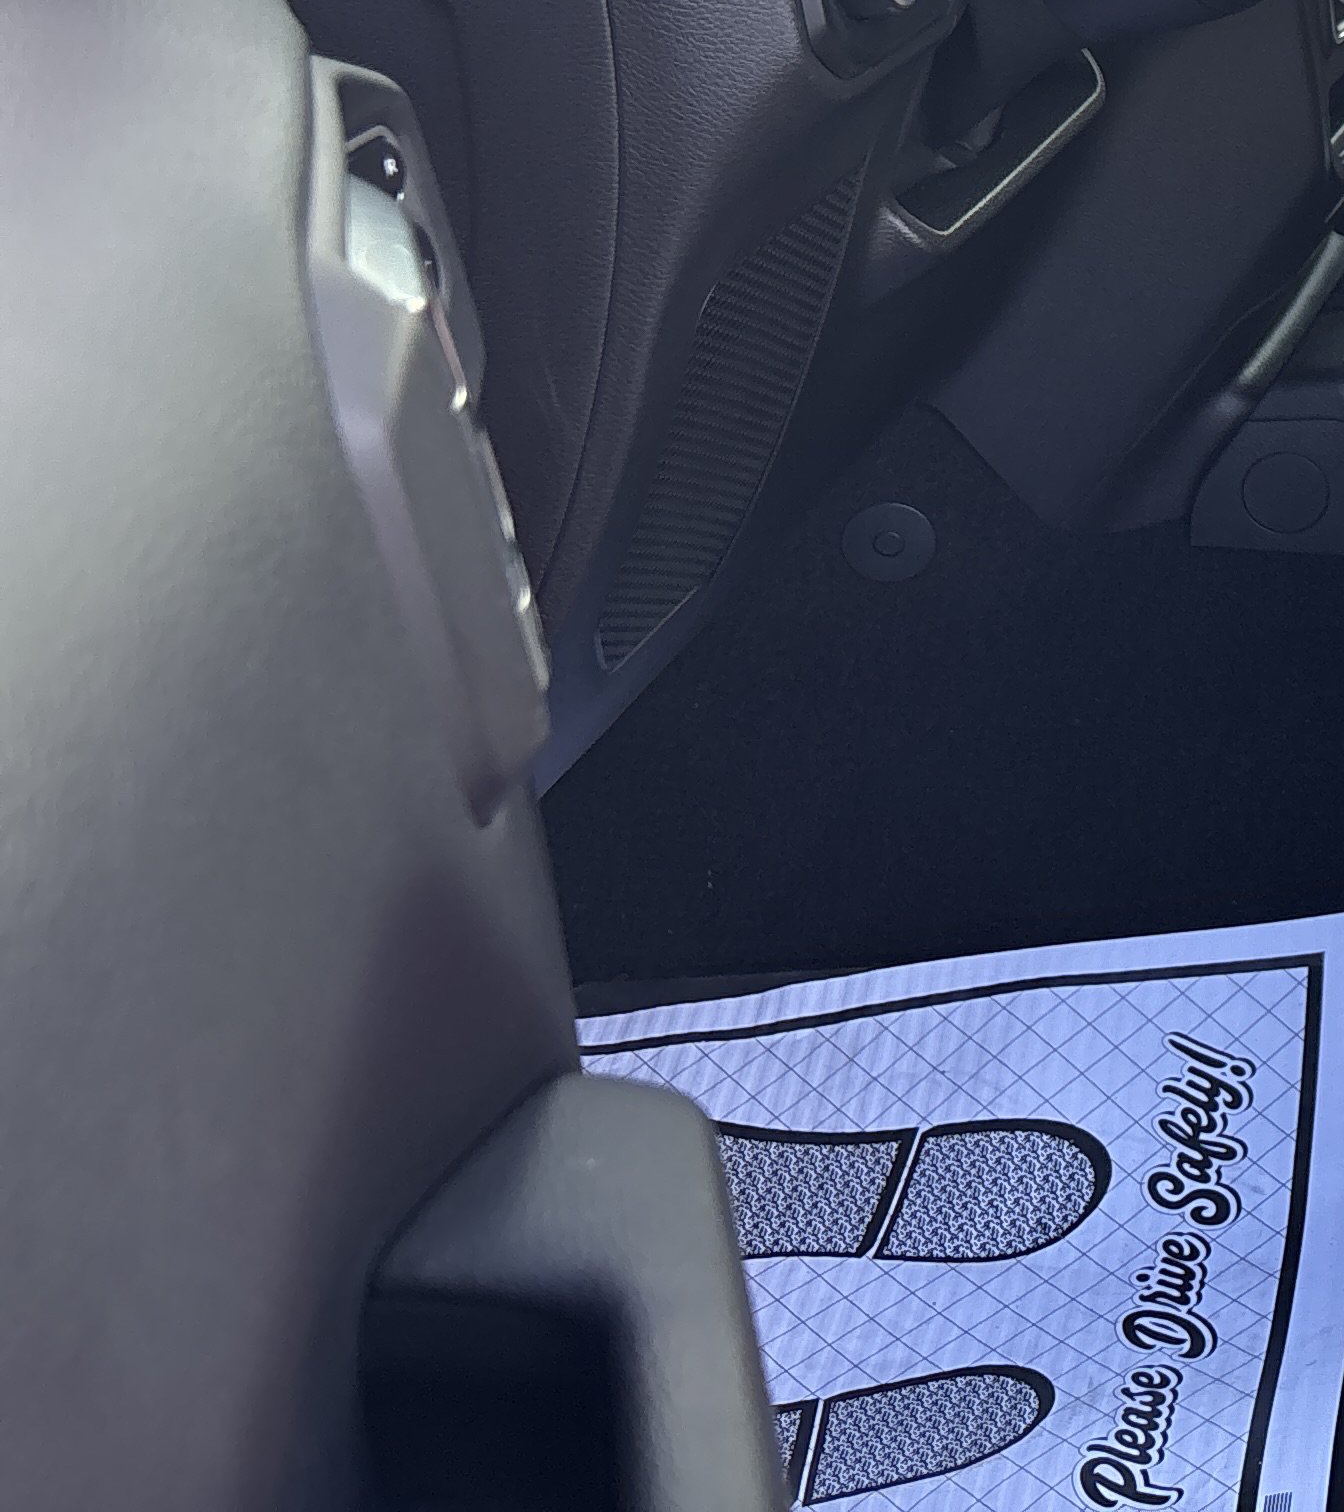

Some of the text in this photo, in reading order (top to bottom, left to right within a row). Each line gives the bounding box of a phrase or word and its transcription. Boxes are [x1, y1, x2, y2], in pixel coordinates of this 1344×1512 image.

[1080, 1035, 1250, 1508] Please Drive Safely!
